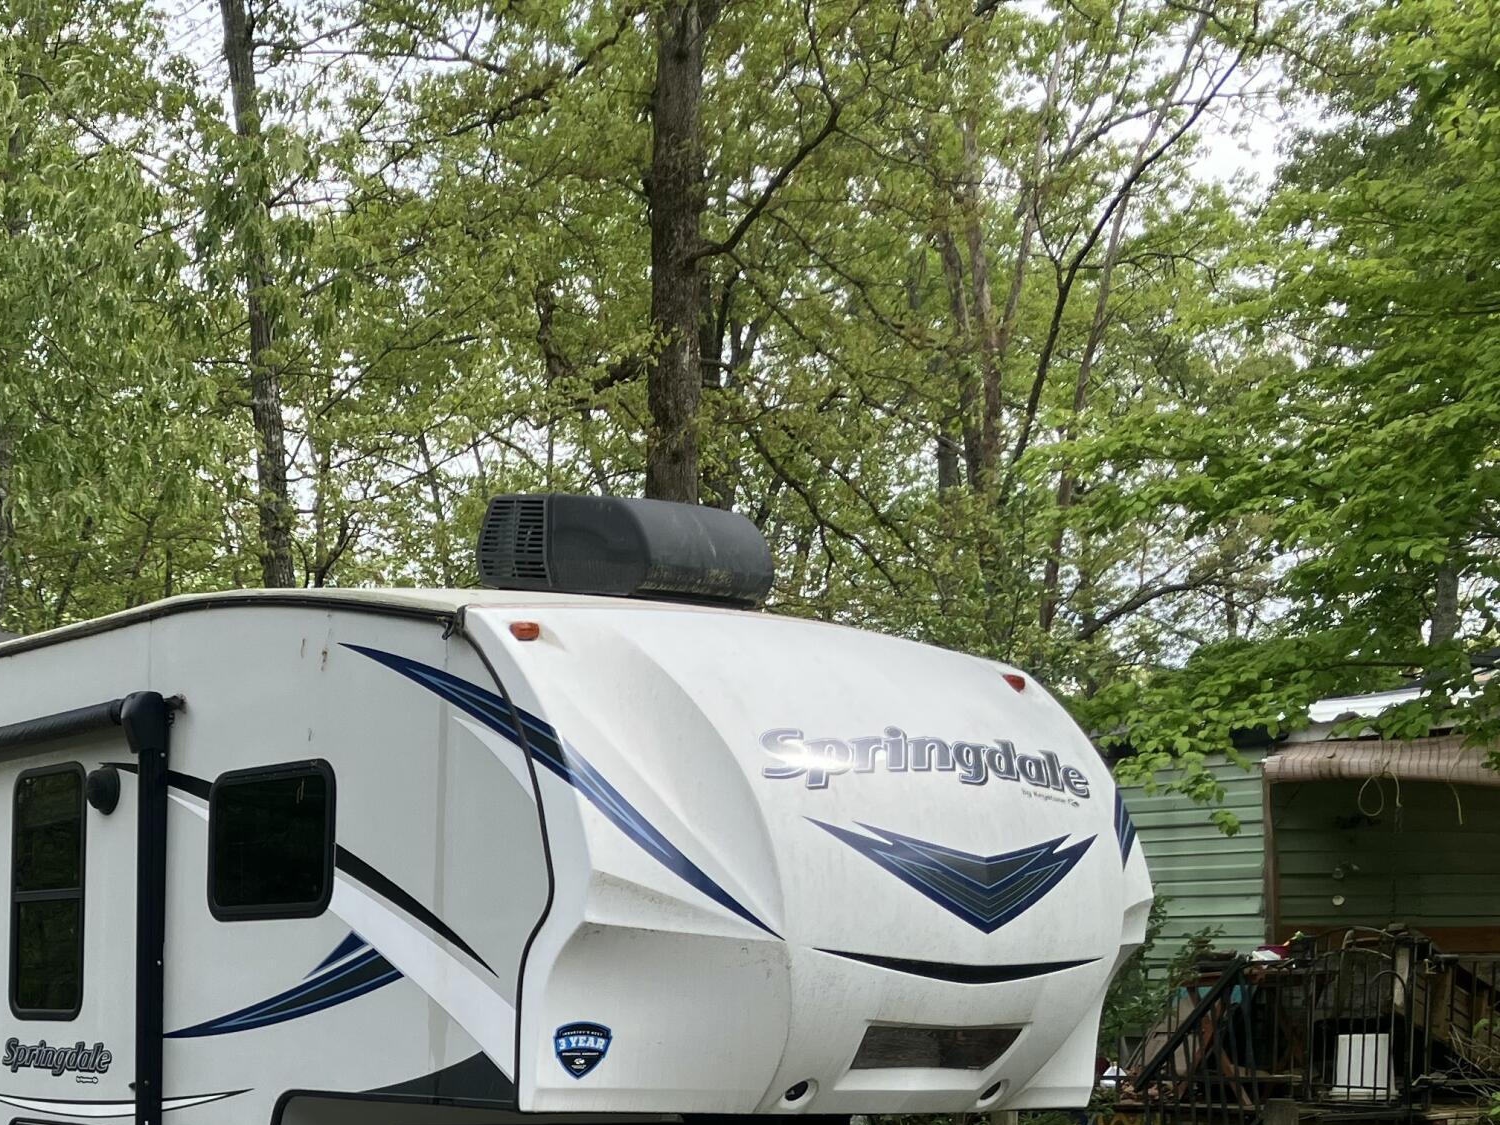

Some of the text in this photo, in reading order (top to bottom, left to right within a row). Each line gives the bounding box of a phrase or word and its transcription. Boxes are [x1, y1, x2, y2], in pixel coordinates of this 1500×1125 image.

[758, 726, 1091, 798] Springdale
[2, 1037, 113, 1077] Springdale
[558, 1035, 606, 1050] 3 YEAR
